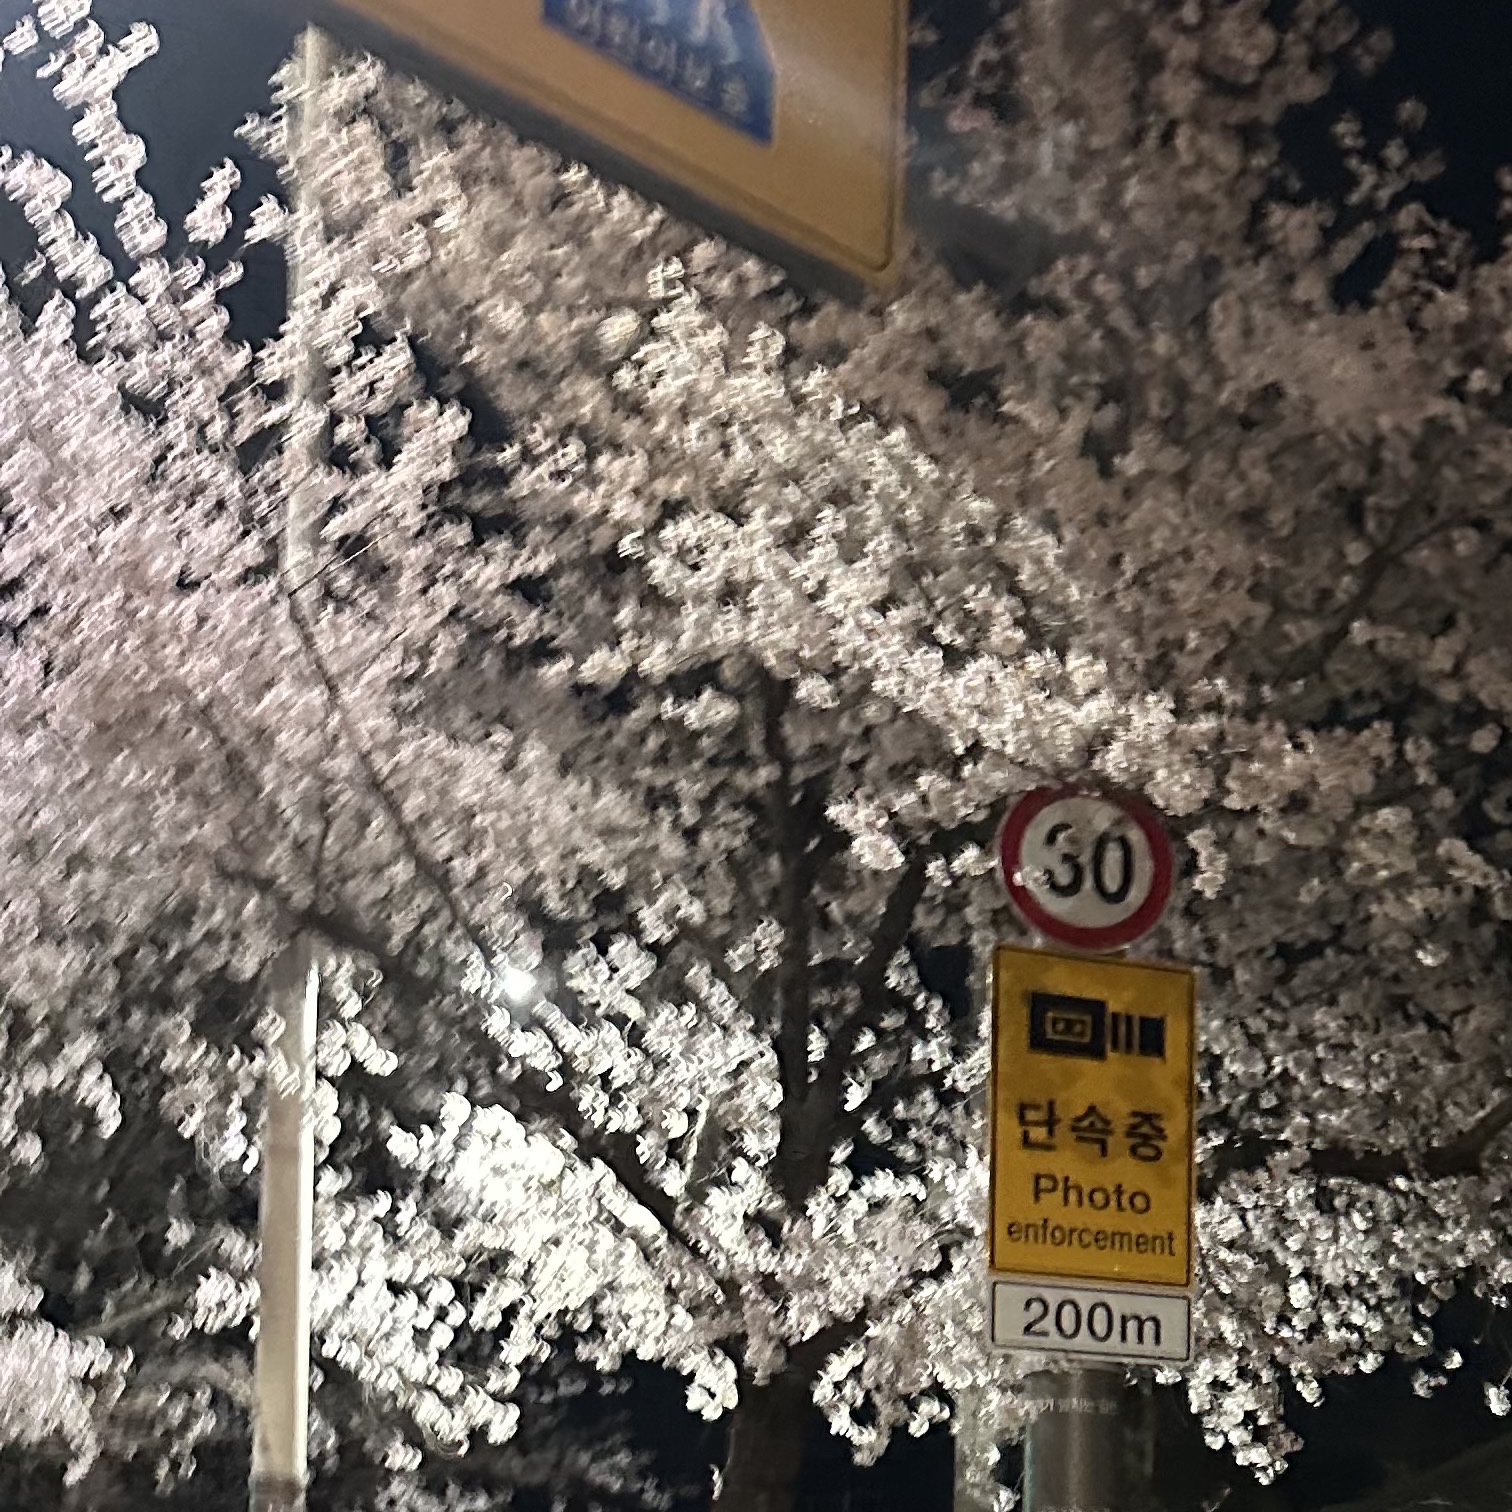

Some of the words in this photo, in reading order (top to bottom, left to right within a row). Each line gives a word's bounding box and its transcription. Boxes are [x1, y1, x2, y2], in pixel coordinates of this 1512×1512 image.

[1043, 822, 1135, 905] 30
[1016, 1098, 1169, 1164] 단속중
[1033, 1172, 1152, 1215] Photo
[1006, 1217, 1177, 1257] enforcement
[1022, 1295, 1162, 1347] 200m
